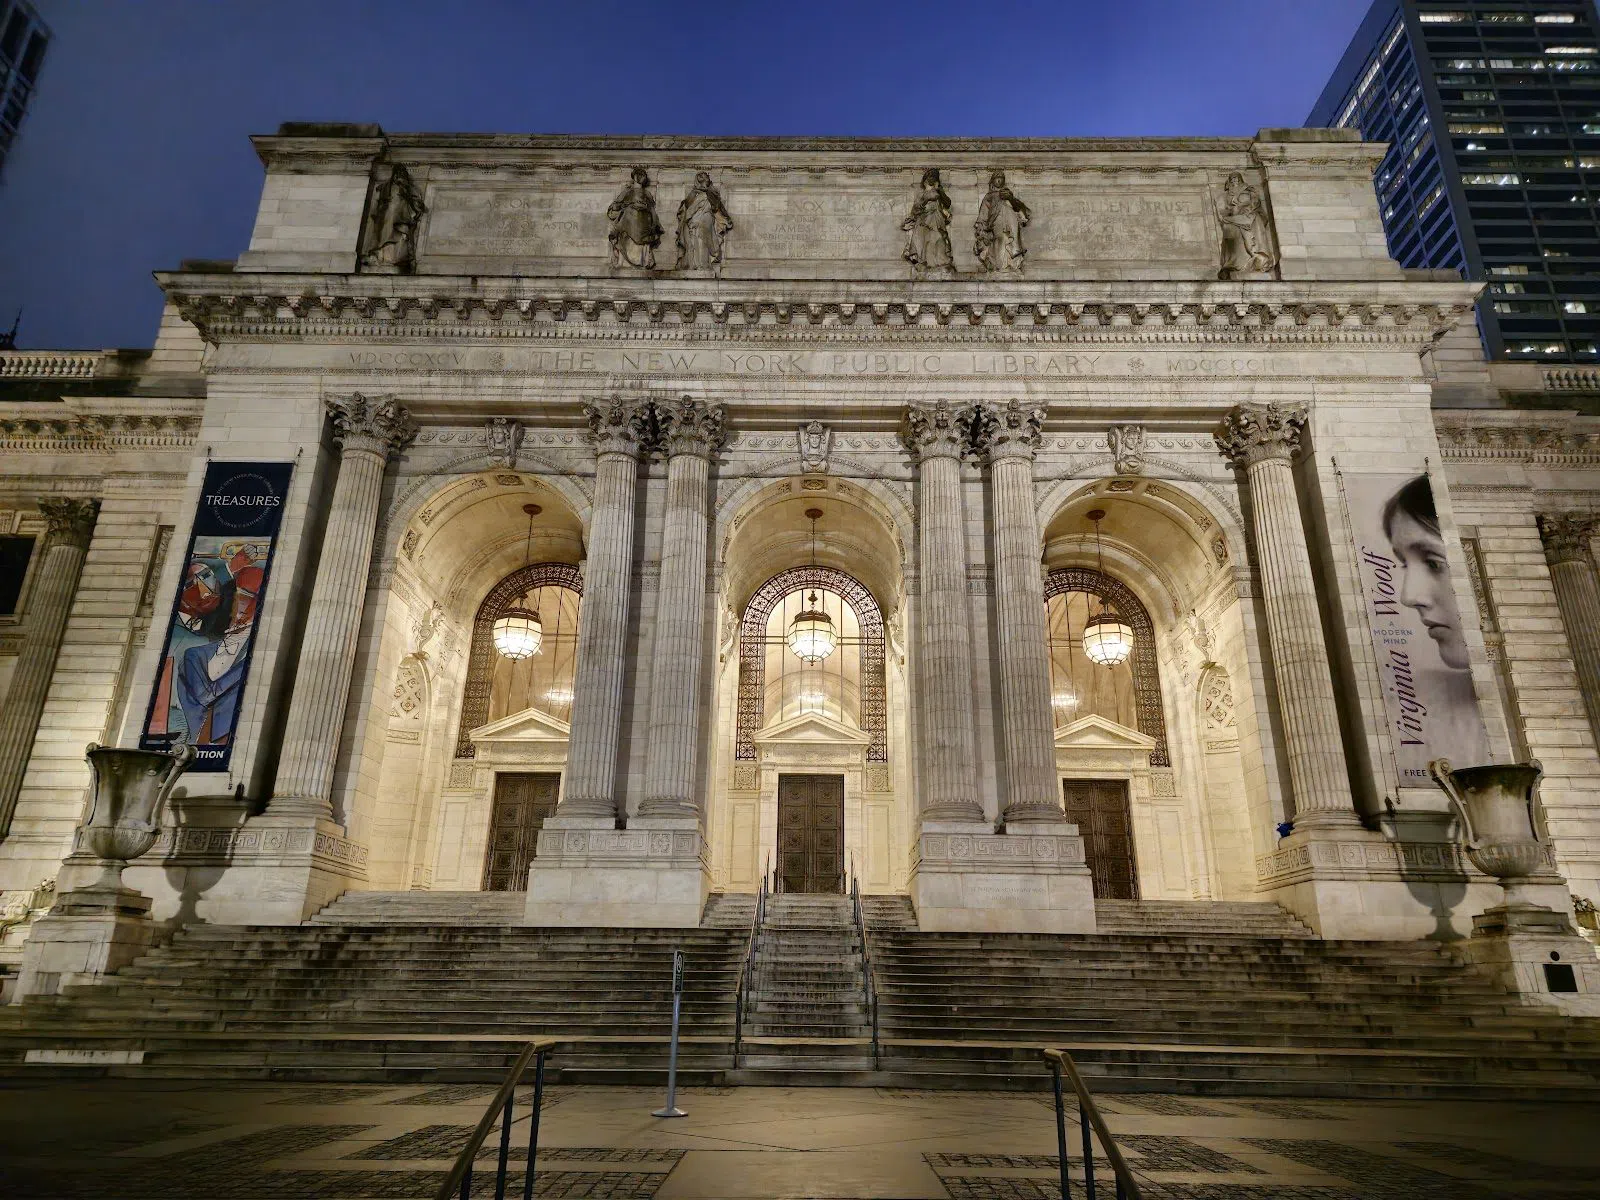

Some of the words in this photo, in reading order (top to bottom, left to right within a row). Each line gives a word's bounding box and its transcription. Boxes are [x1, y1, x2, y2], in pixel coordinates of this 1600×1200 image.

[350, 351, 465, 366] MDCCCXCV
[532, 351, 596, 370] THE
[621, 352, 697, 371] NEW
[725, 354, 806, 373] YORK
[832, 354, 942, 373] PUBLIC
[971, 354, 1101, 374] LIBRARY
[1167, 358, 1276, 373] MDCCCCII
[205, 495, 281, 507] TREASURES
[1361, 545, 1400, 616] Woolf
[1385, 650, 1428, 746] Virginia
[1404, 769, 1427, 777] FREE
